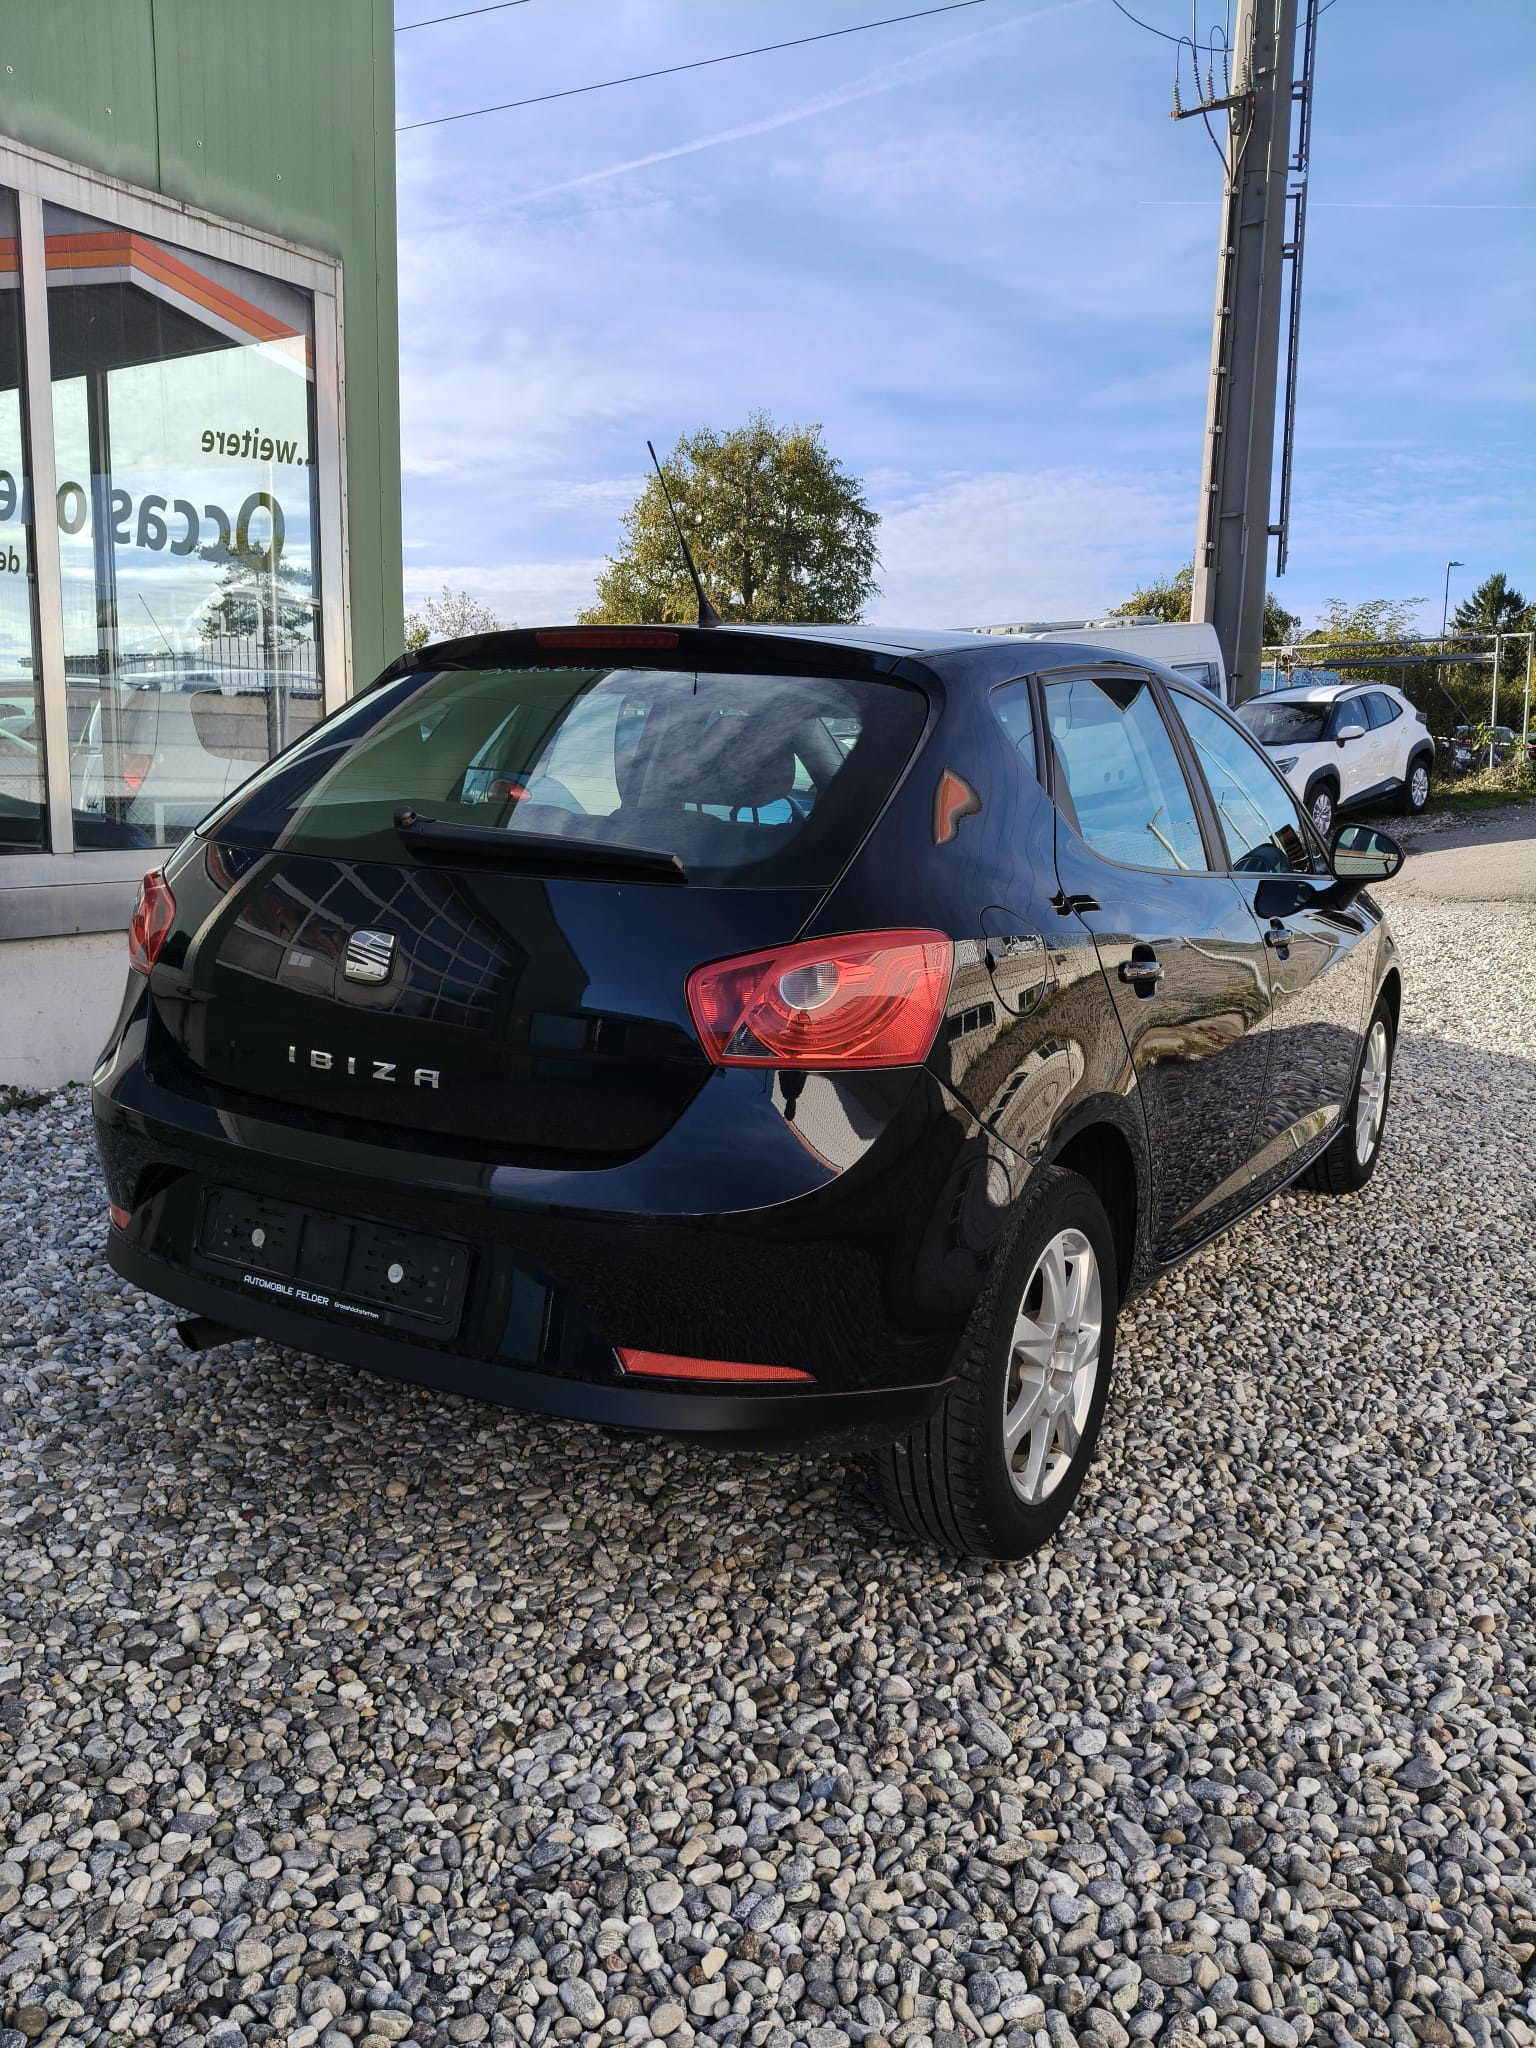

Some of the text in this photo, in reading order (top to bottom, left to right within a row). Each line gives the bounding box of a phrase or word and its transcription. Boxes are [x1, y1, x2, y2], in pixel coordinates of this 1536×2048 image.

[288, 1045, 441, 1089] IBIZA
[243, 1274, 294, 1296] AUTOMOBILE
[295, 1289, 330, 1306] FELDER
